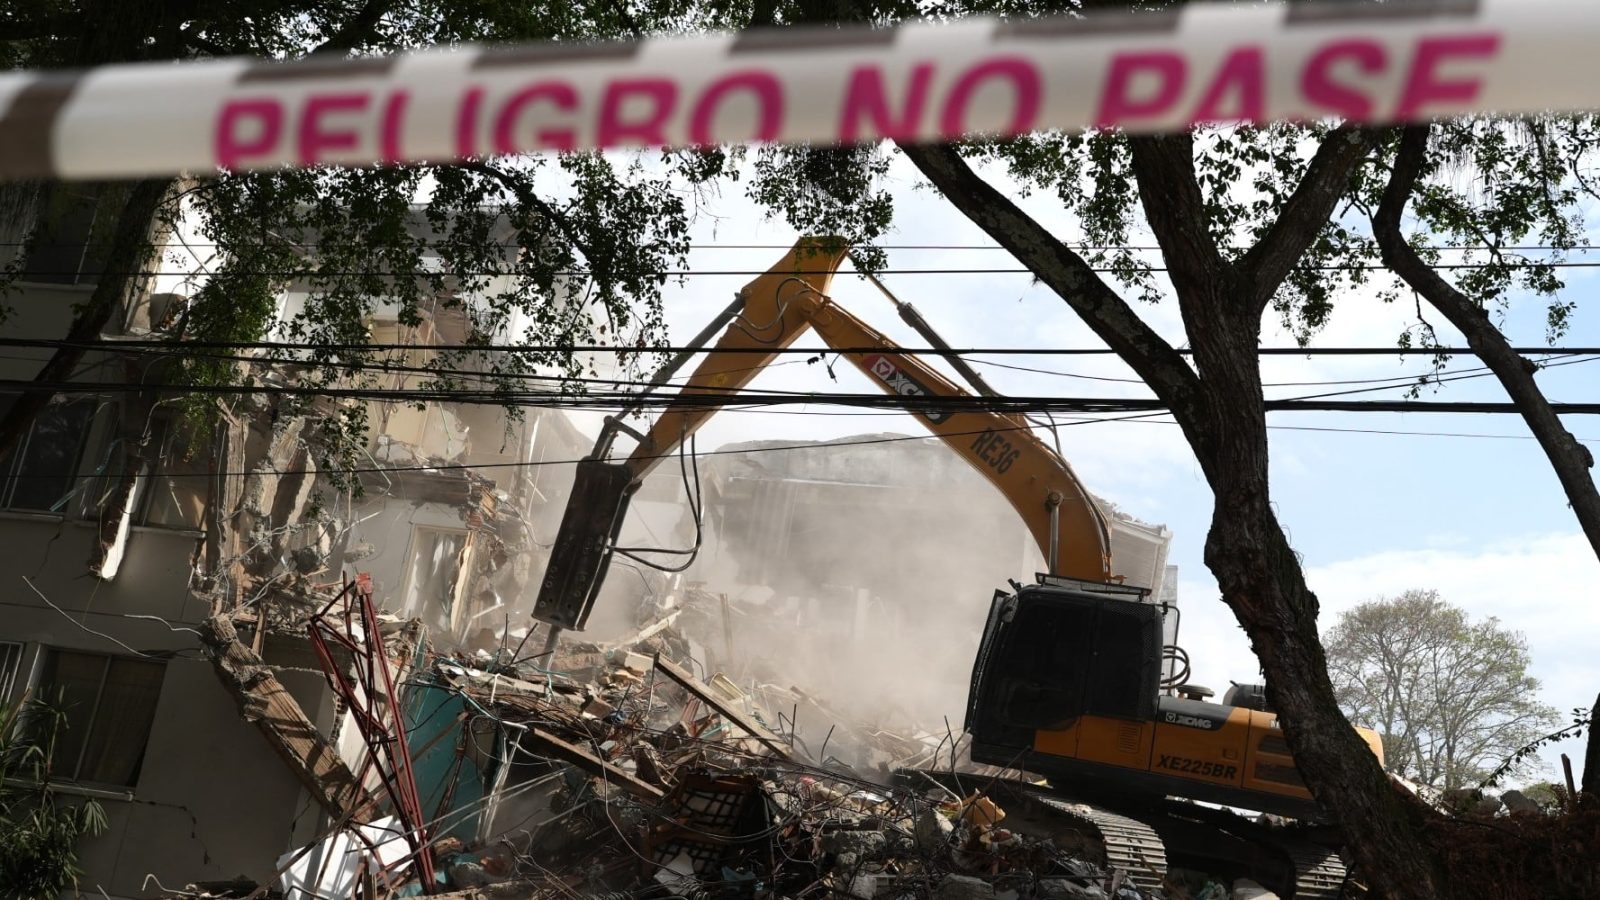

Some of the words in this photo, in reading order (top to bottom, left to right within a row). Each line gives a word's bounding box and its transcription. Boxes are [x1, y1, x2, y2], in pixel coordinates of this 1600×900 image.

[214, 68, 784, 170] PELIGRO
[838, 55, 1043, 142] NO
[1095, 34, 1501, 131] PASE
[970, 427, 1020, 474] RE36
[1176, 715, 1212, 729] XCMG
[1156, 754, 1237, 780] XE225BR
